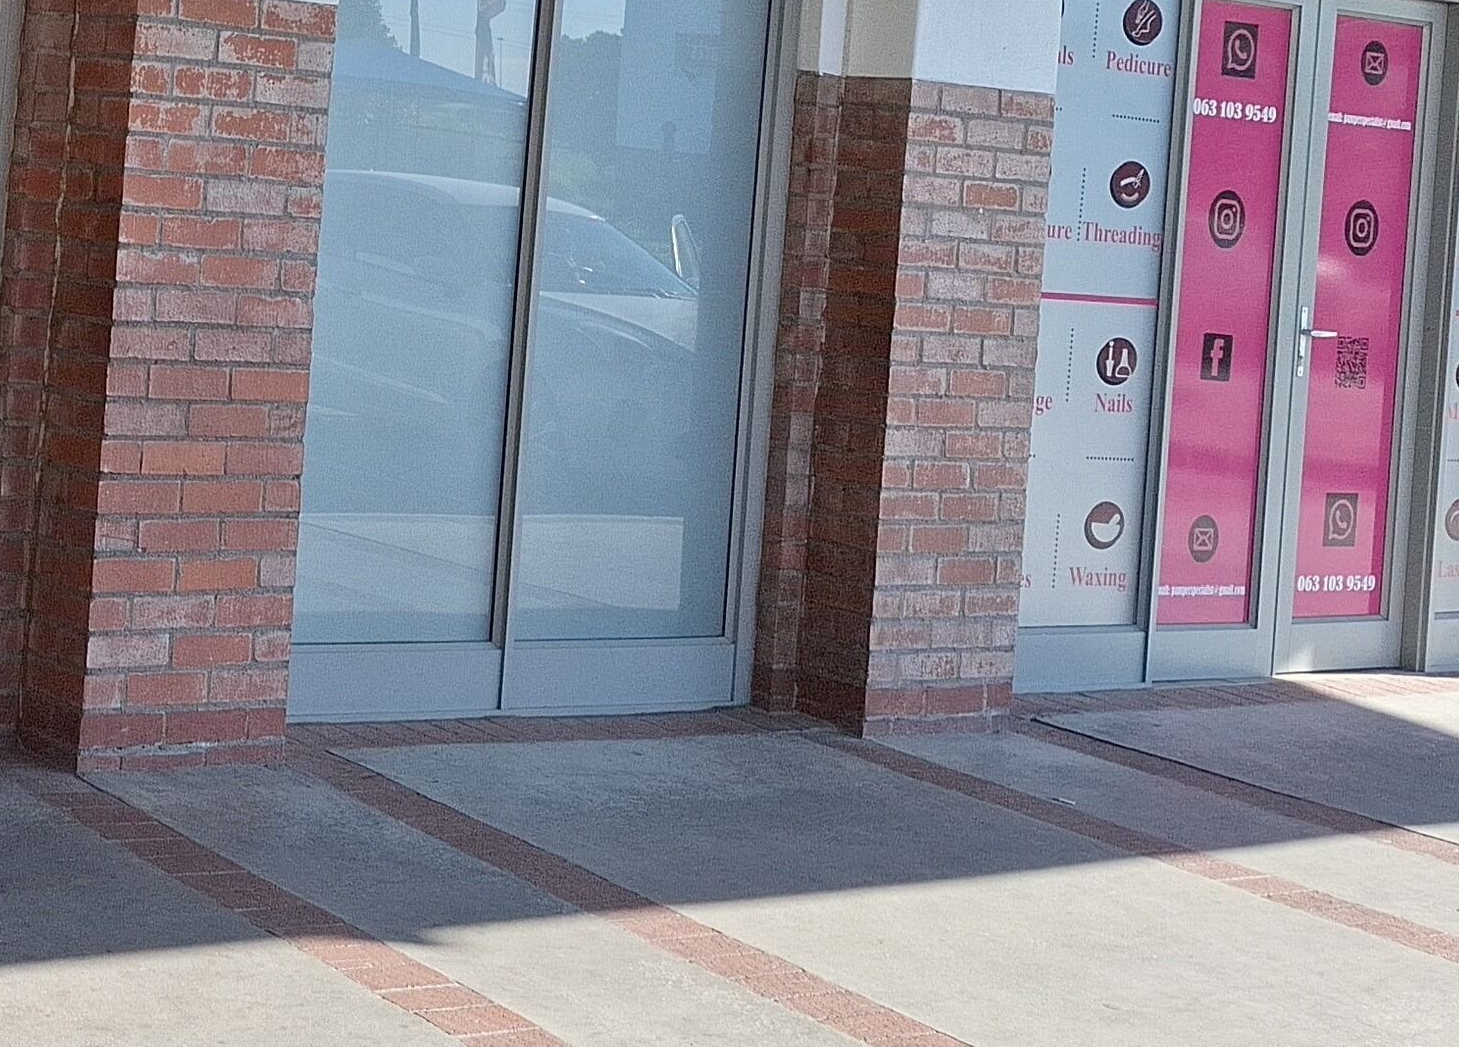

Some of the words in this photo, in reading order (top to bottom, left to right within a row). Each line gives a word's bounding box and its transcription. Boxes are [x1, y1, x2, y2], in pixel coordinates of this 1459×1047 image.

[1106, 50, 1172, 78] Pedicure
[1193, 97, 1217, 118] 063
[1220, 100, 1243, 120] 103
[1245, 104, 1277, 123] 9549
[1082, 221, 1162, 251] Threading
[1094, 392, 1133, 413] Nails
[1069, 566, 1127, 592] Waxing
[1297, 575, 1320, 592] 063
[1323, 575, 1344, 592] 103
[1346, 575, 1376, 592] 9549
